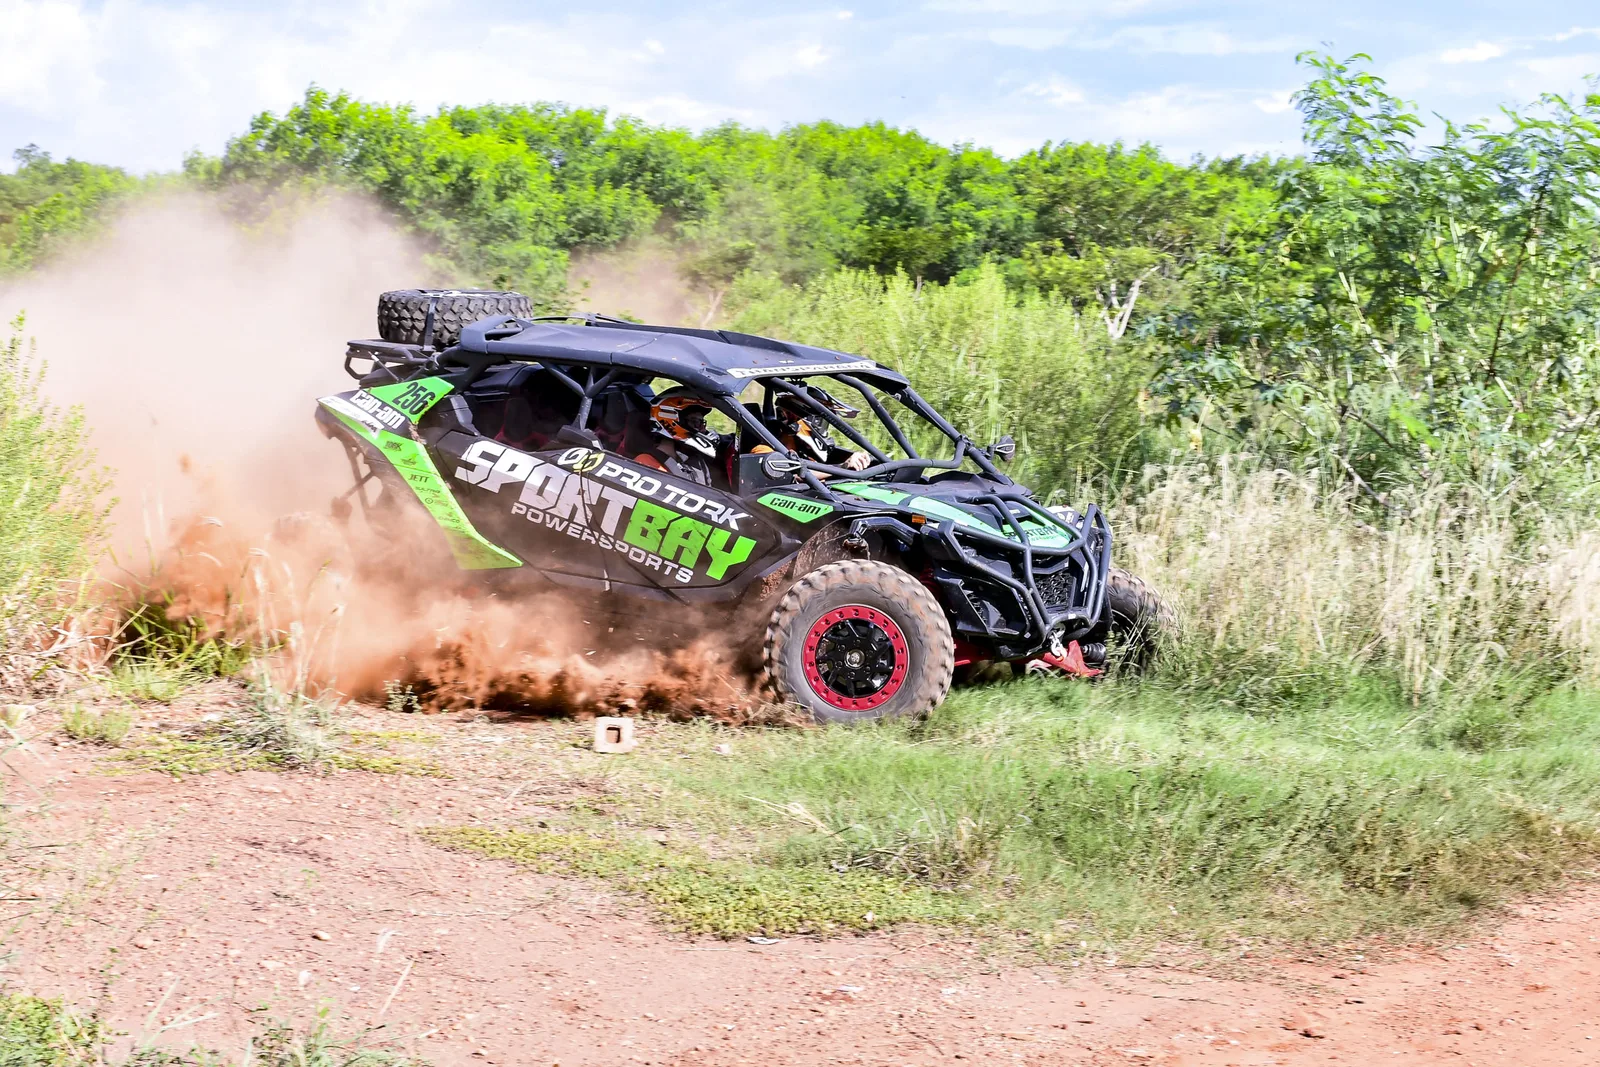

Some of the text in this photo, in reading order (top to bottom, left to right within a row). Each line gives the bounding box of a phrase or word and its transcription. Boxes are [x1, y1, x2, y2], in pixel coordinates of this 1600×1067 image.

[350, 389, 405, 429] can-am
[392, 381, 436, 415] 256
[409, 474, 429, 483] JETT
[595, 461, 750, 531] PRO TORK
[770, 497, 821, 515] can-am
[511, 502, 694, 583] POWERSPORTS
